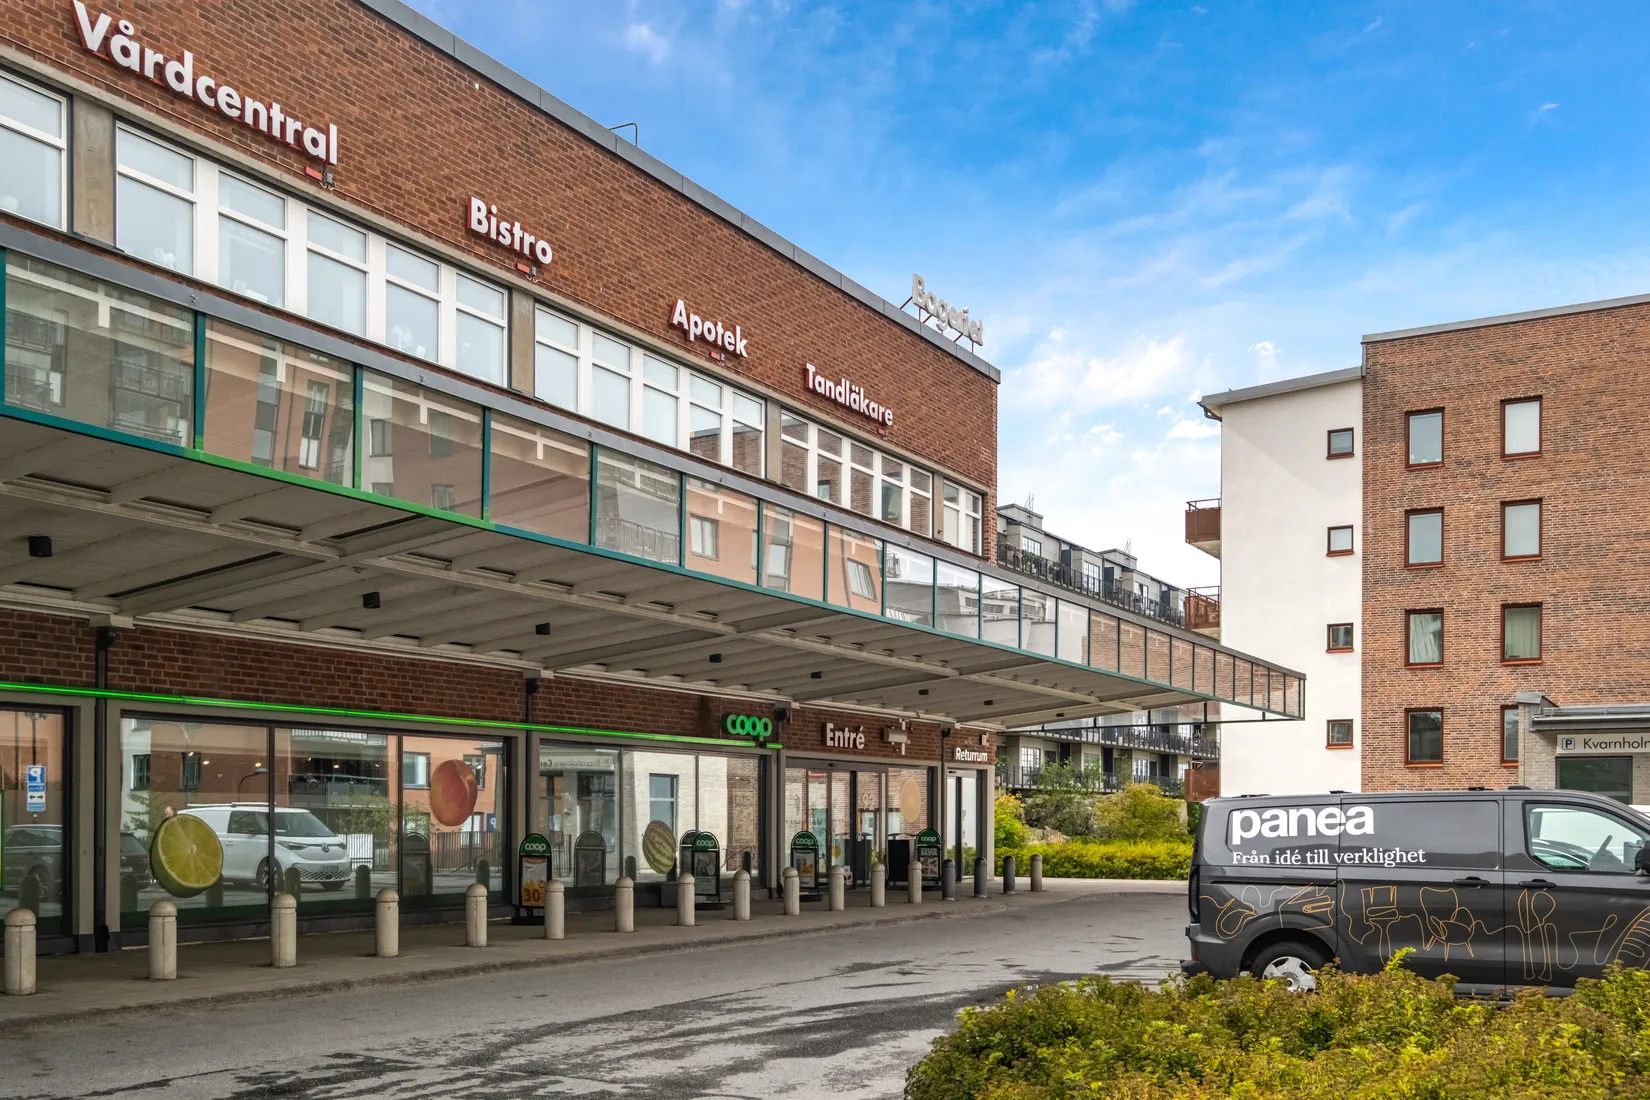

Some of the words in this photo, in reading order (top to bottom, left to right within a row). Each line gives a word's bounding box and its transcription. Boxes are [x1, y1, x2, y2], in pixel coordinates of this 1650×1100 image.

[72, 0, 338, 166] Vårdcentral
[468, 195, 553, 265] Bistro
[670, 298, 748, 359] Apotek
[805, 362, 894, 427] Tandläkare
[726, 713, 773, 742] coop
[825, 722, 865, 750] Entré
[1566, 739, 1573, 749] P
[955, 747, 988, 763] Returrum
[1232, 806, 1375, 845] panea
[524, 842, 547, 853] coop
[696, 839, 715, 848] coop
[795, 838, 814, 846] coop
[920, 835, 937, 843] coop
[1232, 850, 1271, 865] Från
[1275, 849, 1302, 865] idé
[1306, 848, 1330, 865] till
[1333, 848, 1427, 867] verklighet
[523, 888, 541, 903] 30
